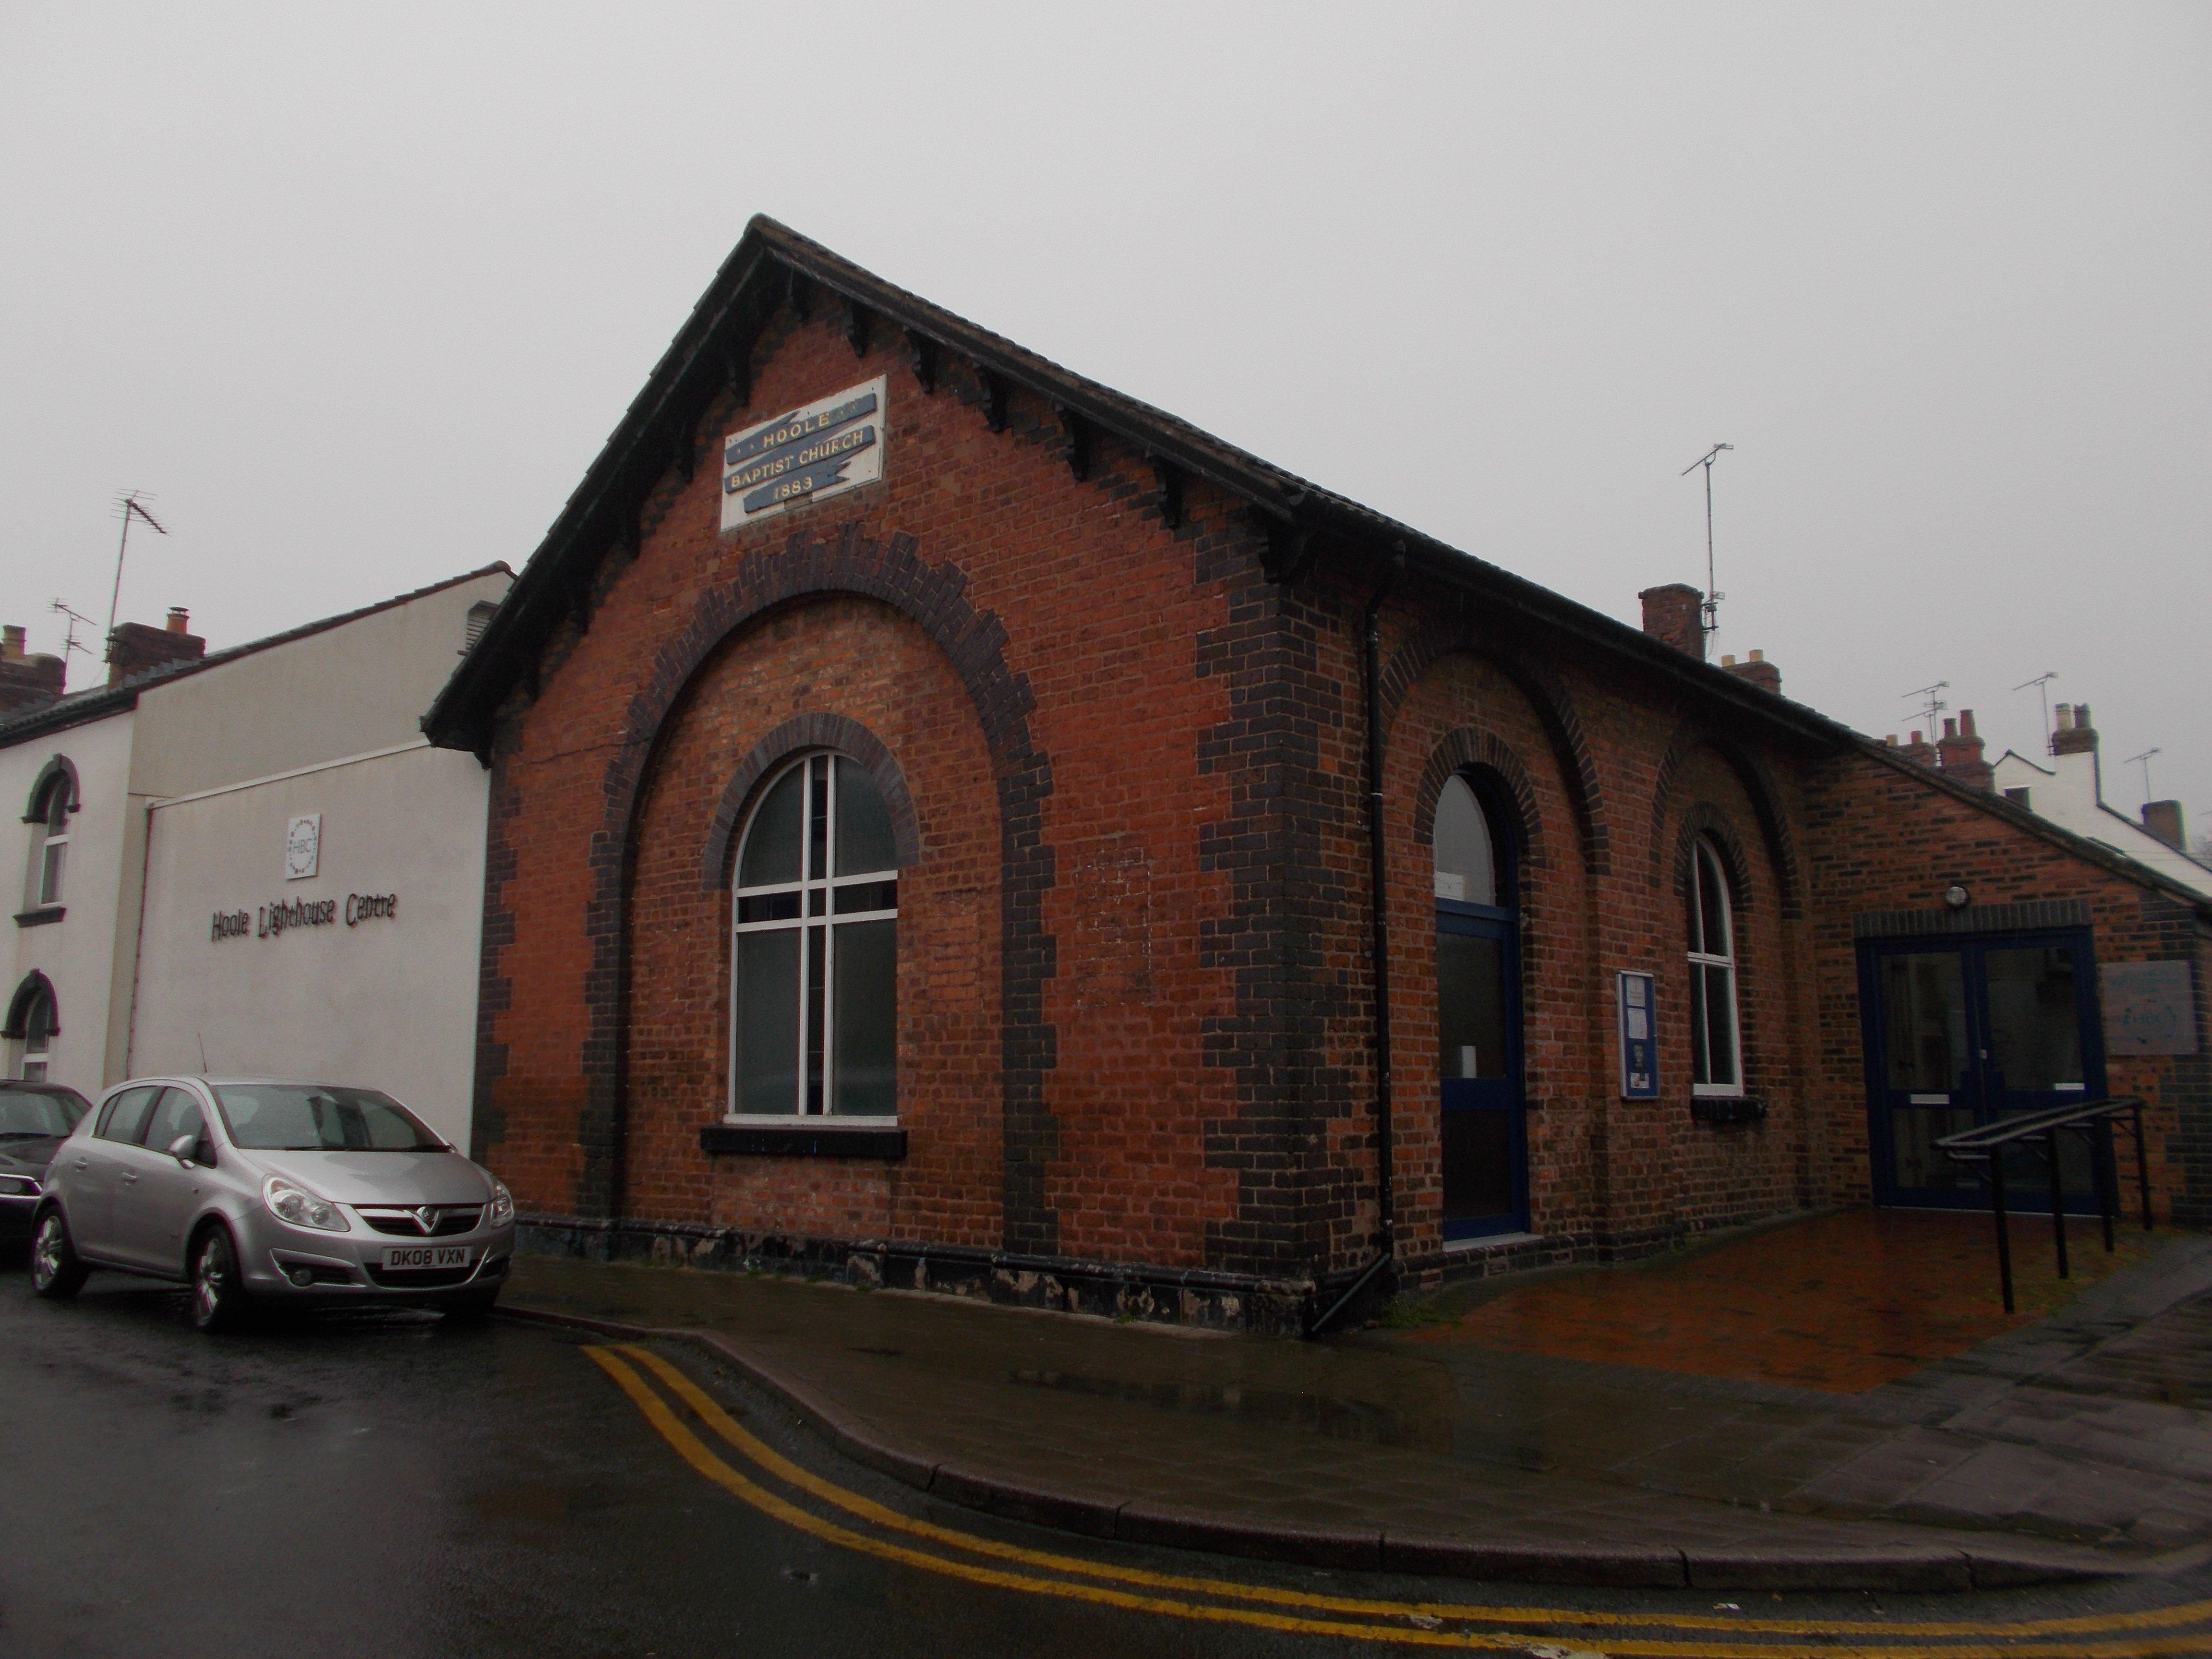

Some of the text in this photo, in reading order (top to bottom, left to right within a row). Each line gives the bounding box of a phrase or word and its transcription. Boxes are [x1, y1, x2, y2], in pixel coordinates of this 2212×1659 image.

[762, 412, 830, 448] HOOLE
[731, 429, 864, 488] BAPTIST CHURCH
[772, 477, 812, 500] 1883
[293, 838, 313, 854] HBC
[212, 893, 397, 942] Hoole Lighthouse Centre
[390, 1249, 465, 1266] DK08 VXN
